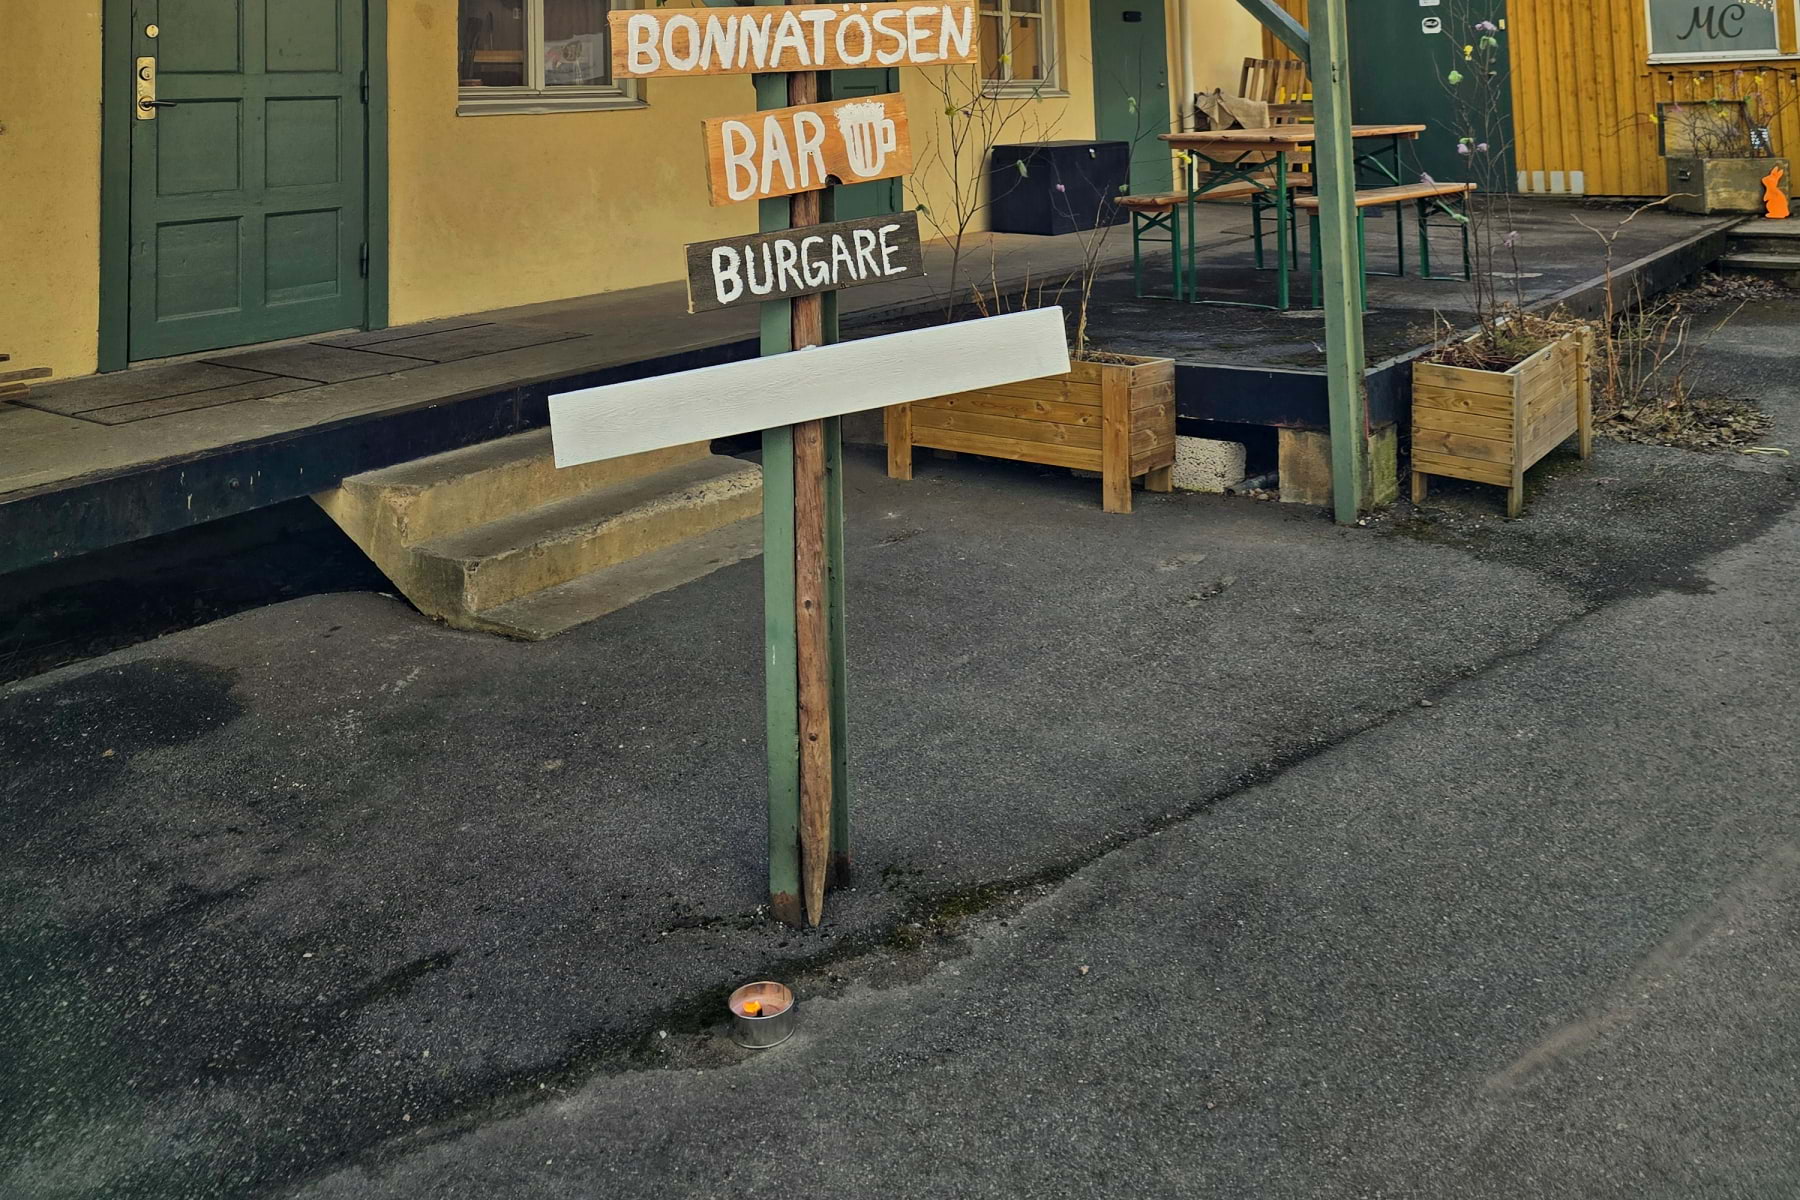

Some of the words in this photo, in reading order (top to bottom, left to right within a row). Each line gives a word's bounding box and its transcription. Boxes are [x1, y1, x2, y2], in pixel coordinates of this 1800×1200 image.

[627, 3, 974, 74] BONNATÖSEN
[1676, 3, 1745, 40] MC
[721, 111, 827, 201] BAR
[711, 223, 907, 304] BURGARE
